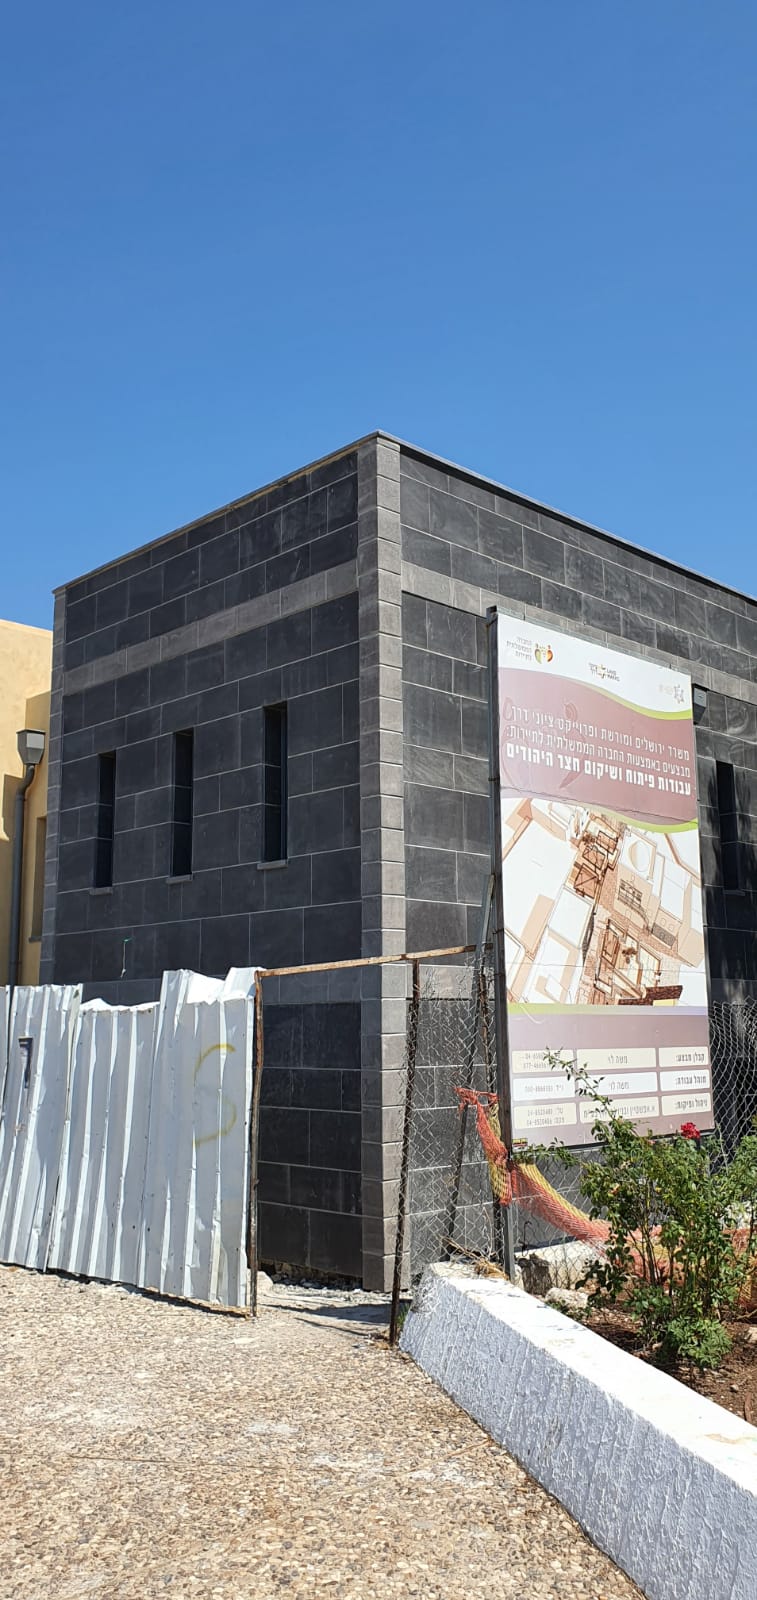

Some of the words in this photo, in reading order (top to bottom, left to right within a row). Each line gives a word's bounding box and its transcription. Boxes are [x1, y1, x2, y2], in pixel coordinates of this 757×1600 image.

[511, 705, 529, 721] דרך
[532, 713, 554, 727] ציוני
[506, 725, 544, 744] לתיירות:
[558, 719, 598, 740] ופרוייקט
[601, 729, 632, 746] ומורשת
[547, 734, 595, 756] הממשלתית
[635, 735, 665, 755] ירושלים
[667, 745, 690, 761] משרד
[506, 743, 554, 767] היהודים
[557, 754, 580, 772] חצר
[597, 747, 624, 762] החברה
[627, 753, 661, 771] באמצעות
[584, 761, 623, 782] ושיקום
[625, 770, 655, 788] פיתוח
[662, 762, 691, 778] מבצעים
[658, 777, 691, 796] עבודות
